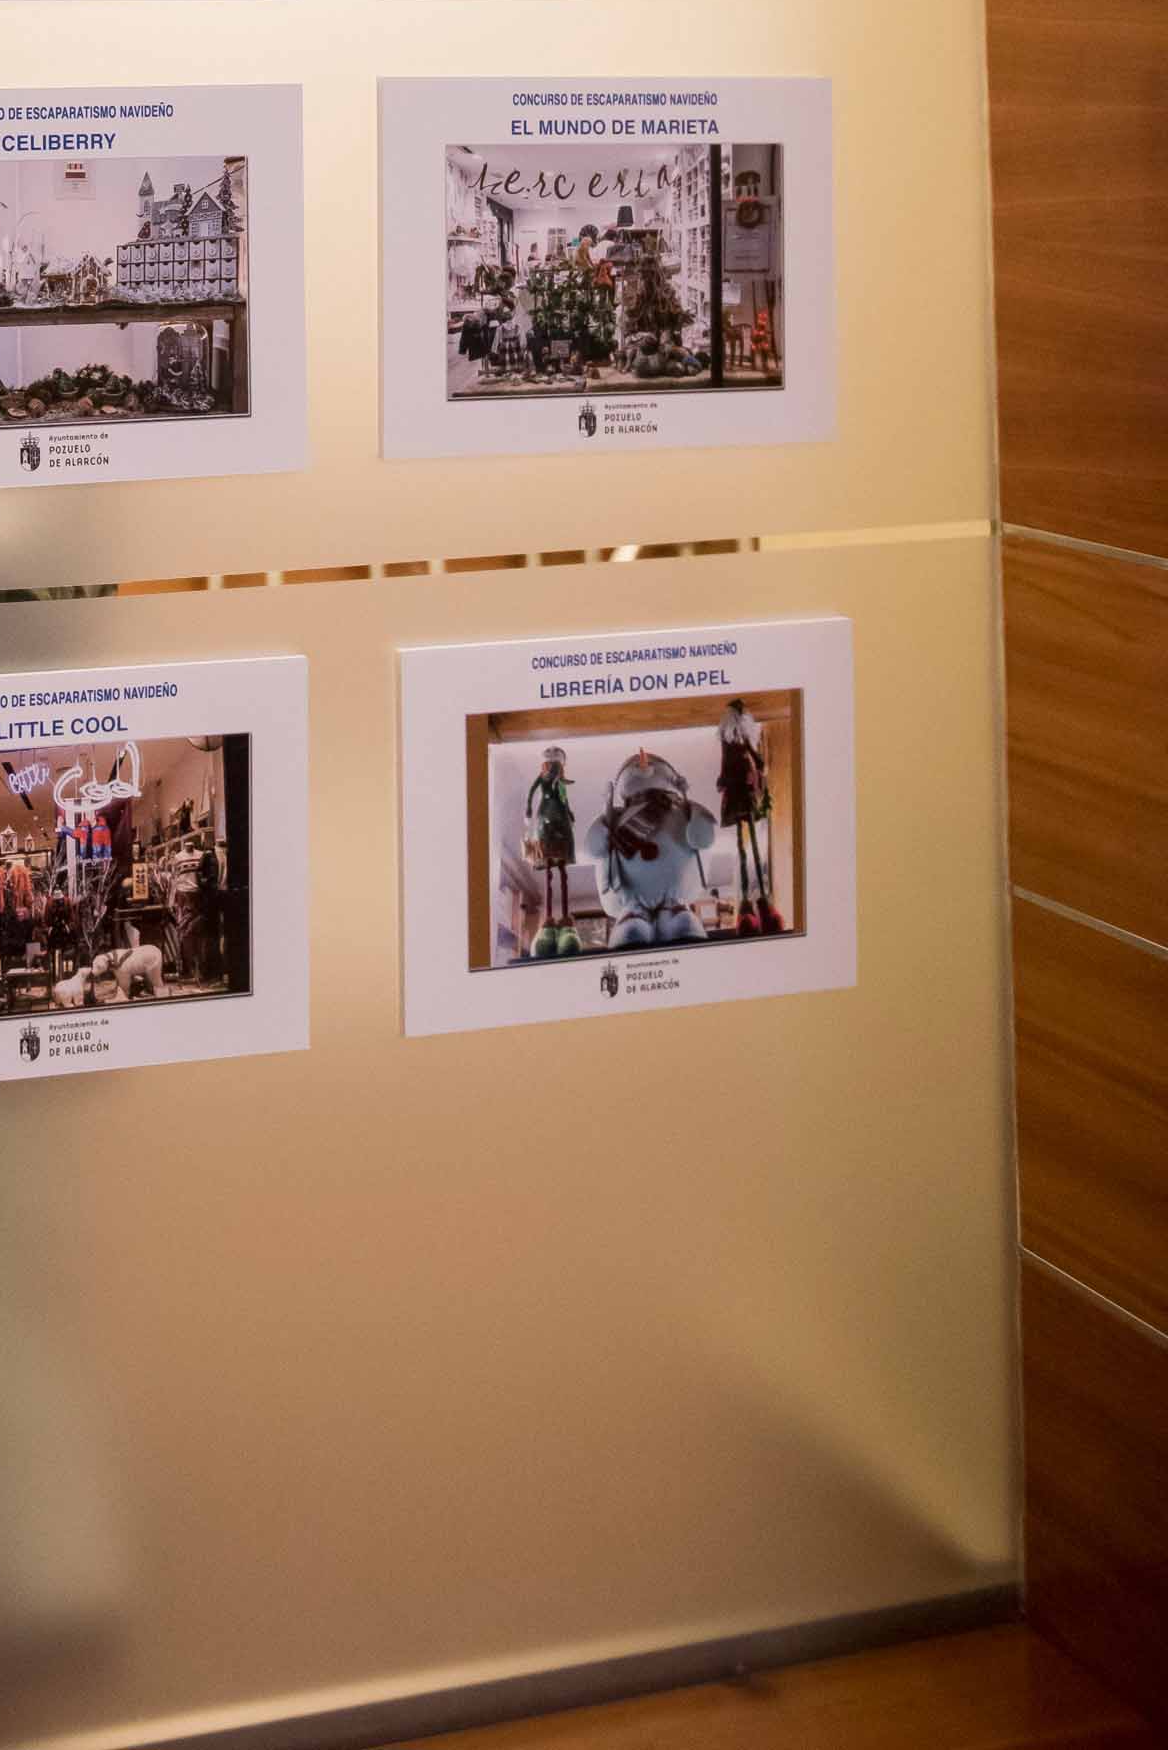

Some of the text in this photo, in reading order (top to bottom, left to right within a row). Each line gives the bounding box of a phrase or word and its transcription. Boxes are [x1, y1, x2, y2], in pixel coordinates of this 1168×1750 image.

[512, 90, 717, 106] CONCURSO DE ESCAPARATISMO NAVIDEÑO
[8, 107, 22, 120] DE
[25, 105, 116, 119] ESCAPARATISMO
[119, 101, 173, 117] NAVIDEÑO
[511, 119, 719, 135] EL MUNDO DE MARIETA
[1, 132, 115, 151] CELIBERRY
[48, 433, 97, 443] Ayuntamiento
[48, 443, 90, 454] POZUELO
[49, 452, 108, 467] DE ALARCÓN
[531, 640, 737, 669] CONCURSO DE ESCAPARATISMO NAVIDEÑO
[540, 669, 730, 698] LIBRERÍA DON PAPEL
[11, 693, 25, 707] DE
[29, 687, 120, 706] ESCAPARATISMO
[123, 681, 177, 699] NAVIDEÑO
[70, 715, 128, 734] COOL
[48, 1019, 97, 1031] Ayuntamiento
[48, 1031, 90, 1043] POZUELO
[49, 1039, 109, 1057] DE ALARCÓN
